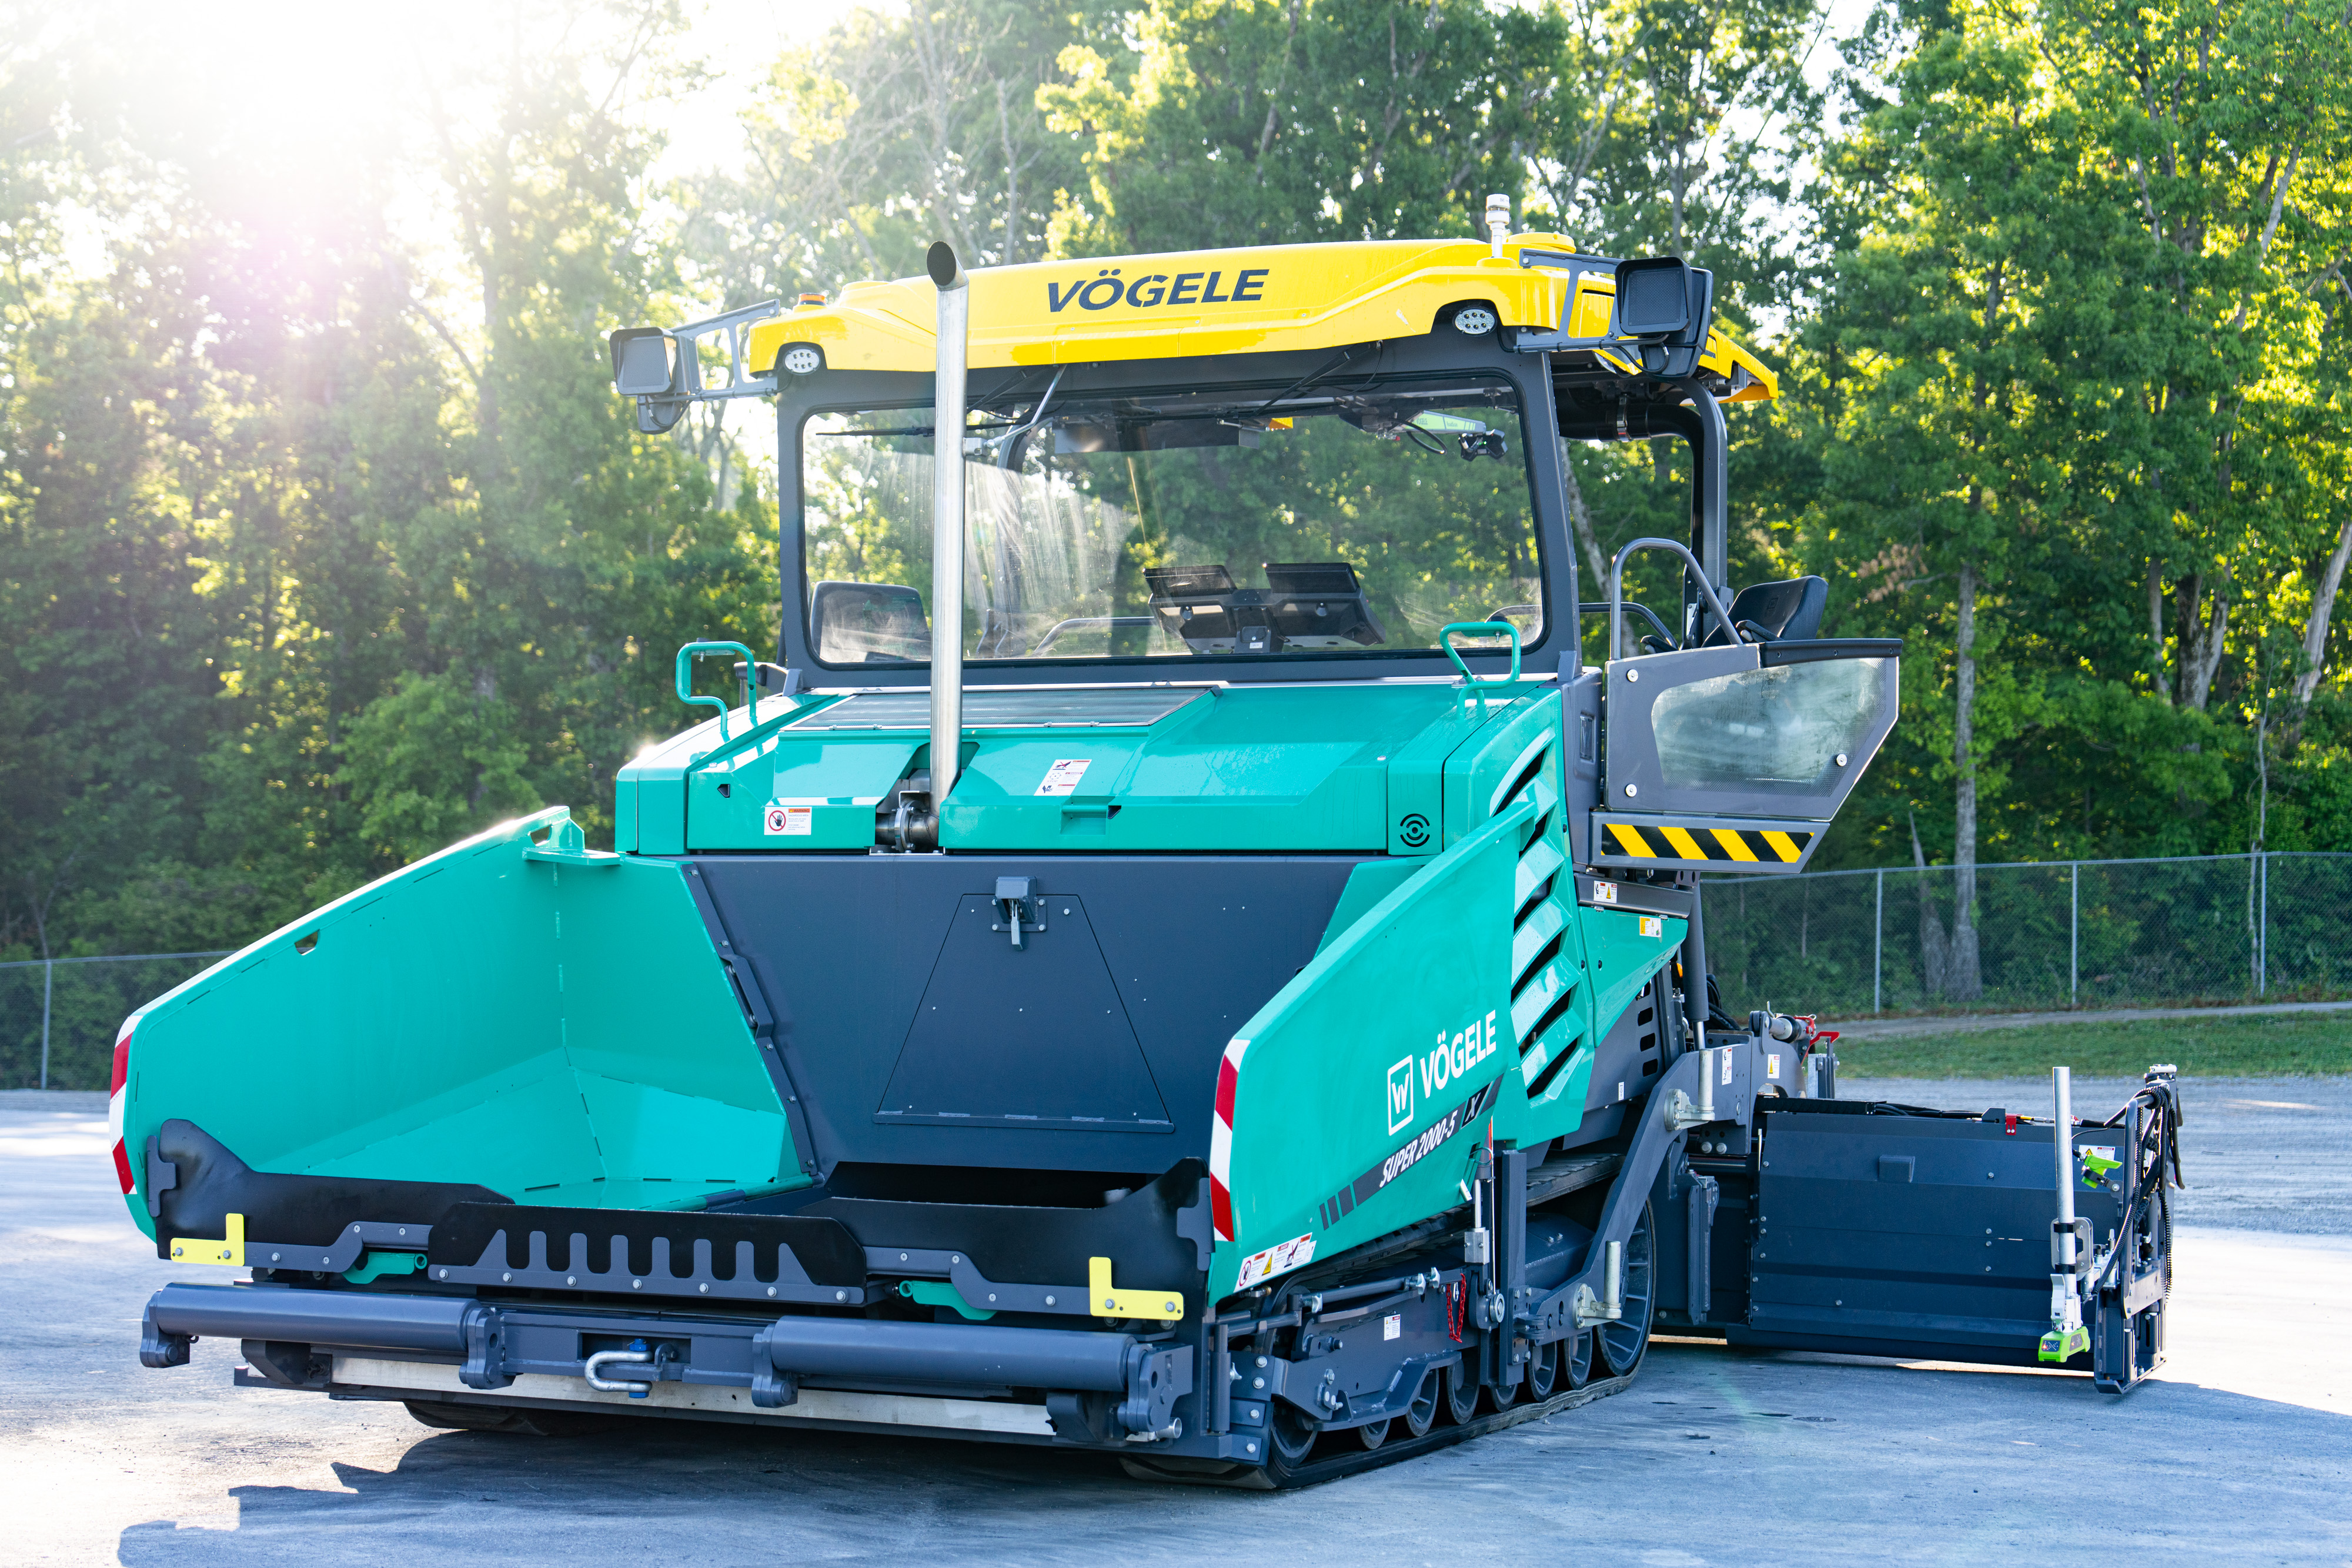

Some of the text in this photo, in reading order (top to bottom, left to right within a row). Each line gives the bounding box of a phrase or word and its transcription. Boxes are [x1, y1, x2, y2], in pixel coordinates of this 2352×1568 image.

[1048, 269, 1270, 313] VÖGELE
[1419, 1009, 1496, 1099] VÖGELE
[1379, 1139, 1418, 1187] SUPER
[1415, 1109, 1458, 1162] 2000-5
